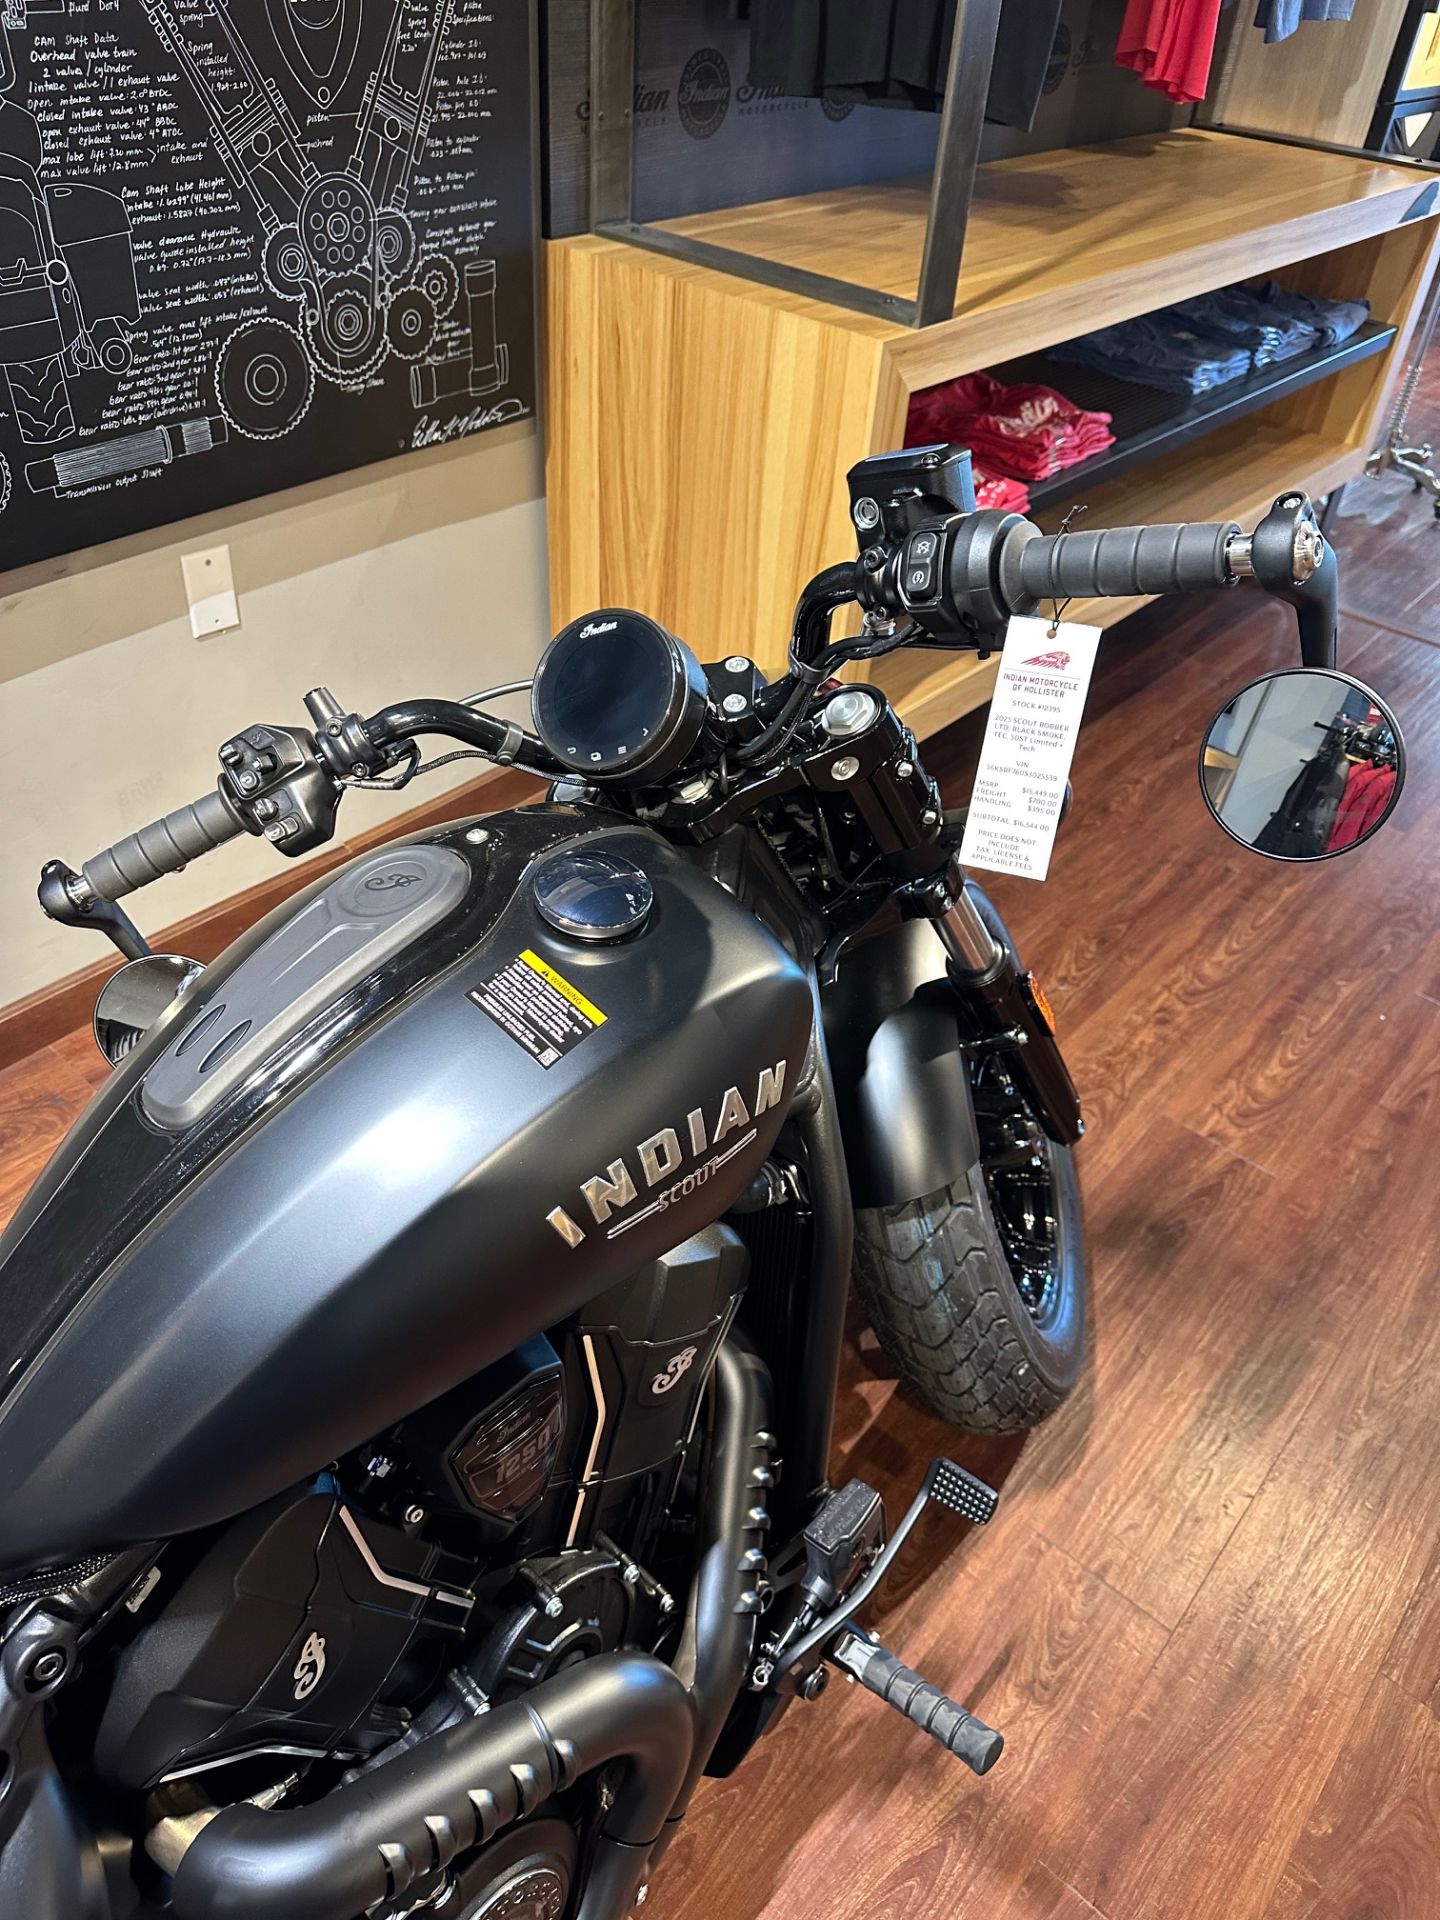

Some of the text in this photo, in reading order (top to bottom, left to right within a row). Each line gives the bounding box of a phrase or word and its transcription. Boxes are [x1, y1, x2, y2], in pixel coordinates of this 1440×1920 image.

[179, 12, 204, 28] spring
[94, 32, 119, 44] Data
[30, 46, 138, 63] Overhead valve train
[187, 41, 213, 55] Spring
[196, 53, 229, 67] installed
[43, 62, 133, 78] 2 valves cylinder
[34, 80, 67, 93] intake
[74, 79, 100, 91] valve
[117, 74, 151, 87] exhaust
[156, 72, 181, 83] valve
[27, 99, 53, 111] open
[60, 95, 91, 106] intake
[37, 109, 65, 122] closed
[71, 107, 103, 120] intake
[68, 123, 102, 134] exhaust
[44, 137, 69, 150] closed
[78, 135, 112, 147] exhaust
[156, 137, 209, 154] intake and
[42, 147, 144, 165] max lobe mm
[171, 151, 204, 165] exhaust
[40, 164, 92, 179] max valve
[198, 177, 226, 191] Height
[185, 238, 227, 254] installed
[79, 426, 99, 436] Gear
[66, 482, 112, 499] Transmission
[579, 621, 618, 639] Indian
[1003, 673, 1079, 692] INDIAN MOTORCYCLE
[1012, 684, 1065, 699] OF HOLLISTER
[1012, 700, 1036, 710] STOCK
[995, 713, 1070, 733] 2025 SCOUT BOBBER
[1012, 726, 1037, 737] BLACK
[1019, 744, 1036, 753] Tech
[1029, 738, 1058, 748] Limited
[1016, 761, 1030, 769] VIN
[979, 779, 999, 789] MSRP
[976, 788, 1007, 799] FREIGHT
[974, 796, 1012, 809] HANDLING
[979, 830, 1036, 847] PRICE DOES NOT
[988, 840, 1020, 853] INCLUDE
[971, 853, 1033, 871] APPLICABLE FEES
[993, 849, 1023, 861] LICENSE
[550, 974, 583, 1005] WARNING
[545, 1059, 787, 1249] INDIAN
[657, 1155, 719, 1212] SCOUT
[495, 1425, 551, 1483] 1250
